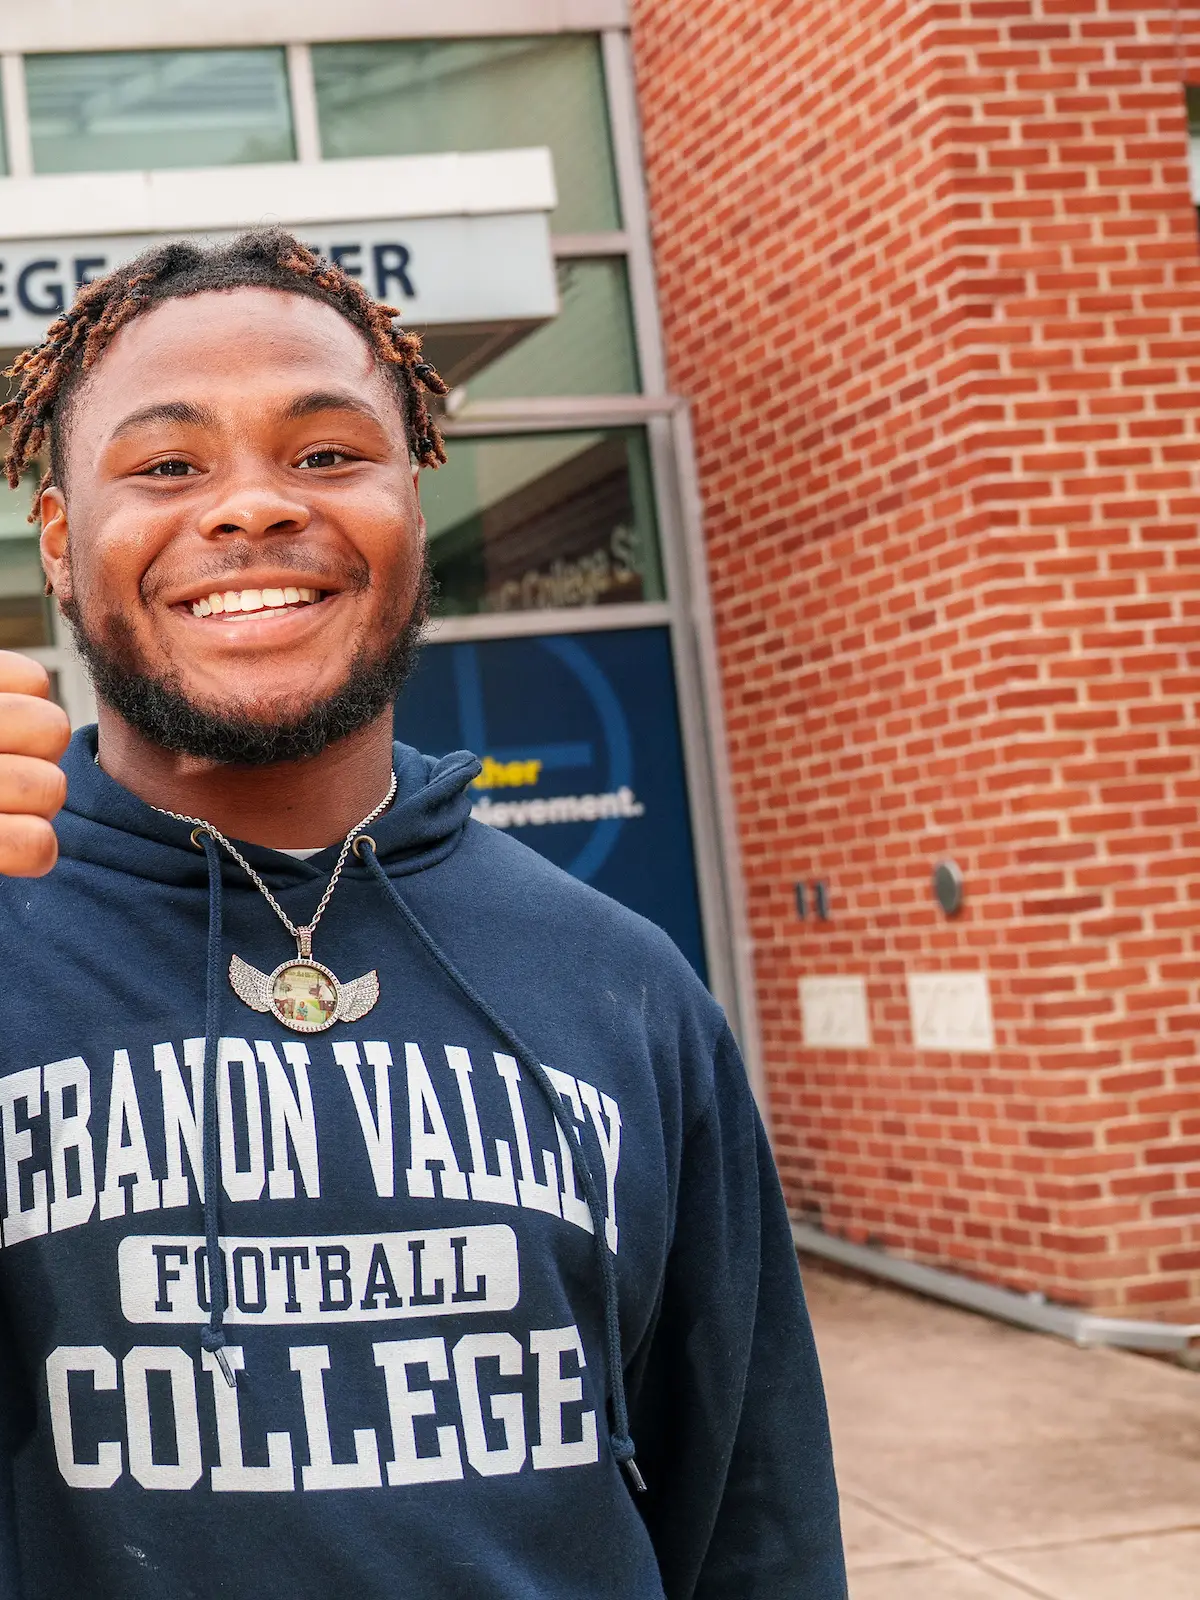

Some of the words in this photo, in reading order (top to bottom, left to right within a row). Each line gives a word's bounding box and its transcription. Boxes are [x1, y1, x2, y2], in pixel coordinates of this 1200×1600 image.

[470, 786, 644, 829] ievement.
[331, 1040, 622, 1255] VALLEY
[152, 1236, 487, 1313] FOOTBALL
[45, 1324, 599, 1492] COLLEGE
